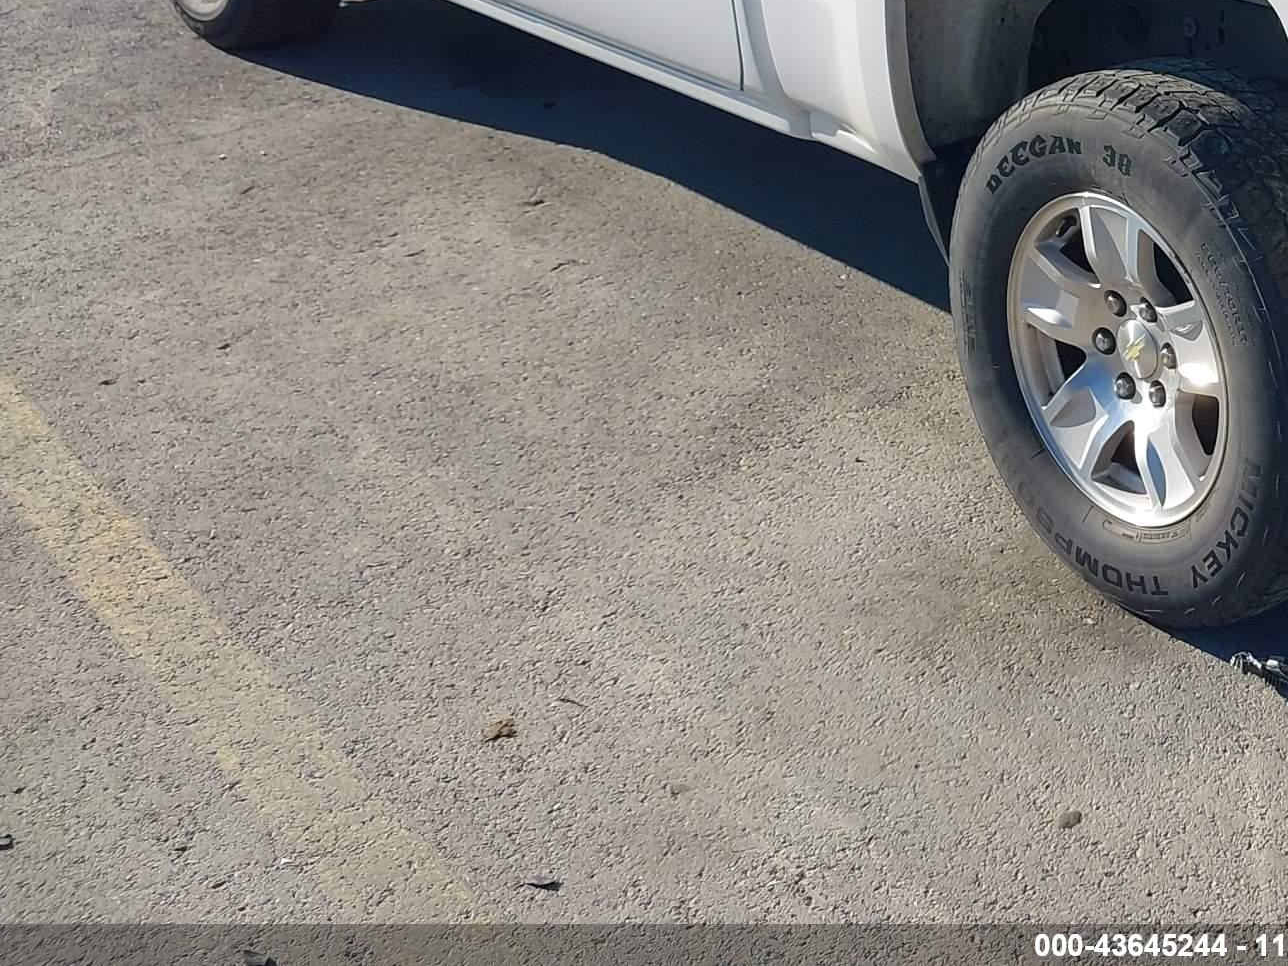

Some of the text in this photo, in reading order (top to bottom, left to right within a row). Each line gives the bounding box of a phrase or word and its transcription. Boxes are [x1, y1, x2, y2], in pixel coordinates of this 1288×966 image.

[985, 135, 1133, 194] DEEGAN 38
[1190, 458, 1262, 589] MICKEY
